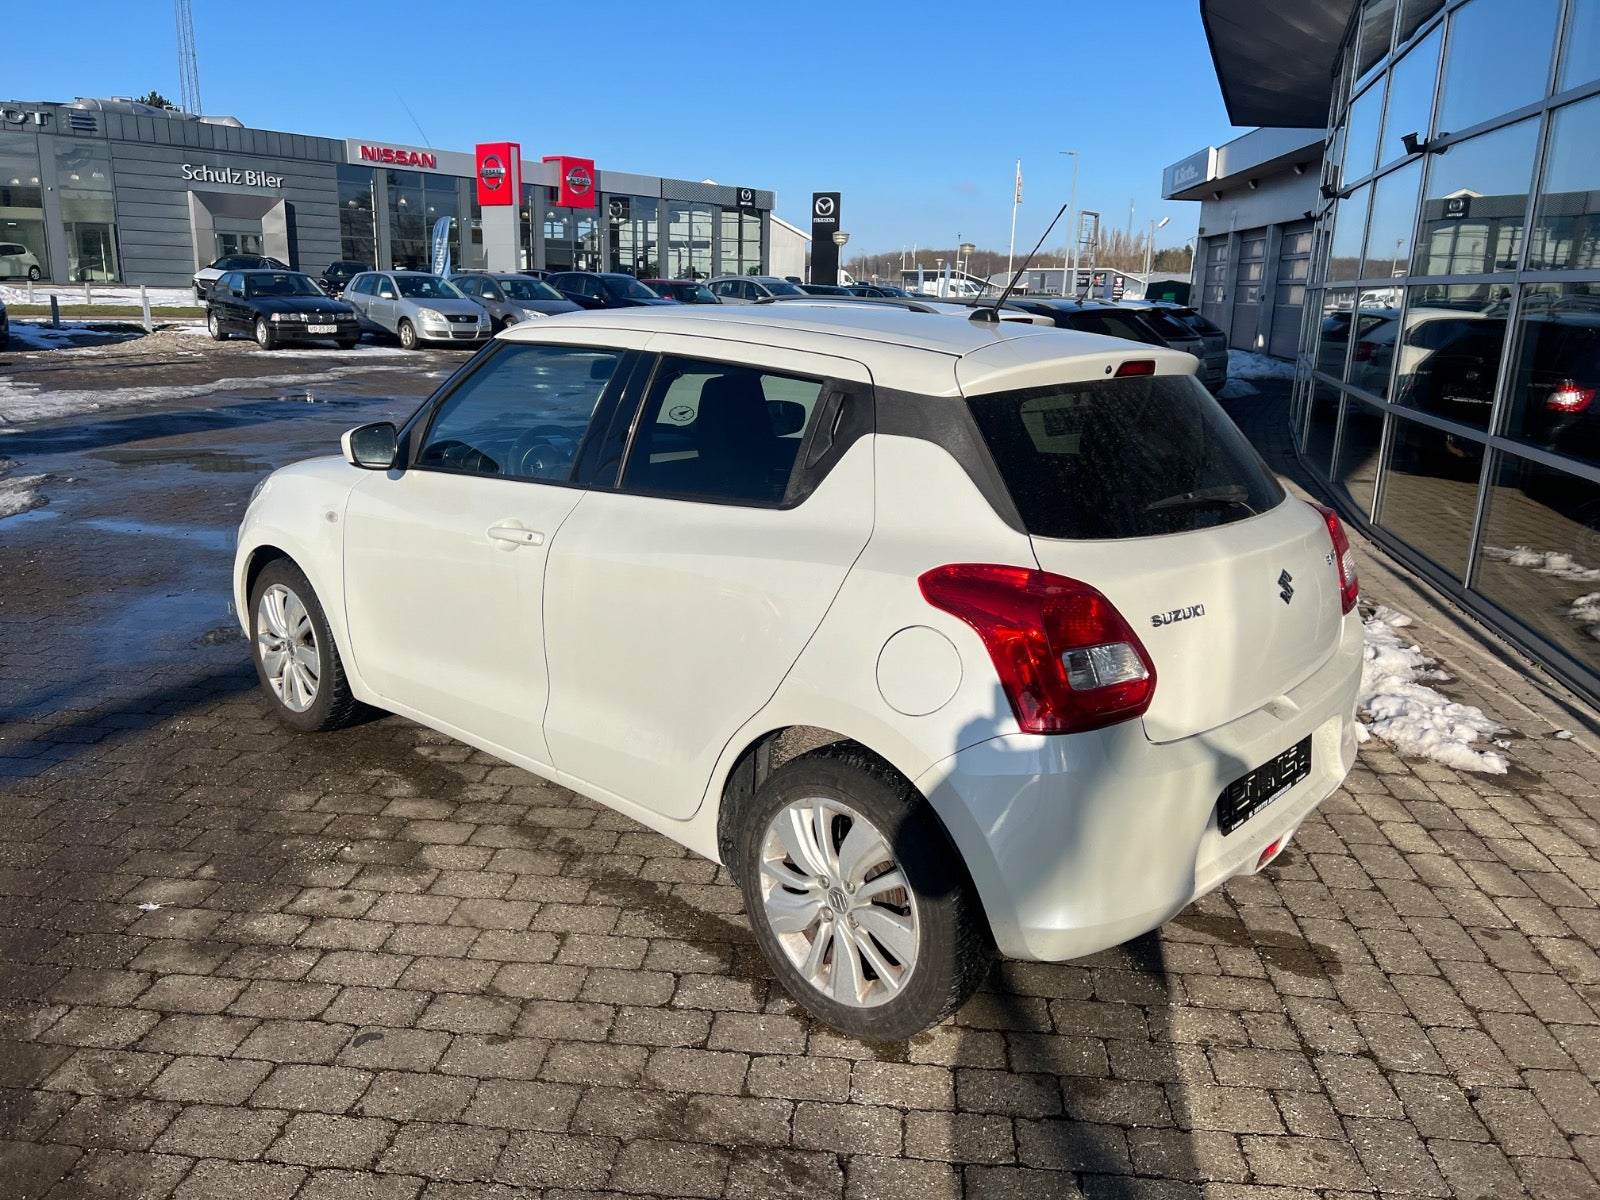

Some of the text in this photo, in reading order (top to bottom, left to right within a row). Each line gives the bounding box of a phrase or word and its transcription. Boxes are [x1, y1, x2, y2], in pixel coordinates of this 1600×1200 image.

[360, 145, 436, 169] NISSAN
[181, 164, 283, 188] Schulz Biler
[1151, 604, 1206, 628] SUZUKI
